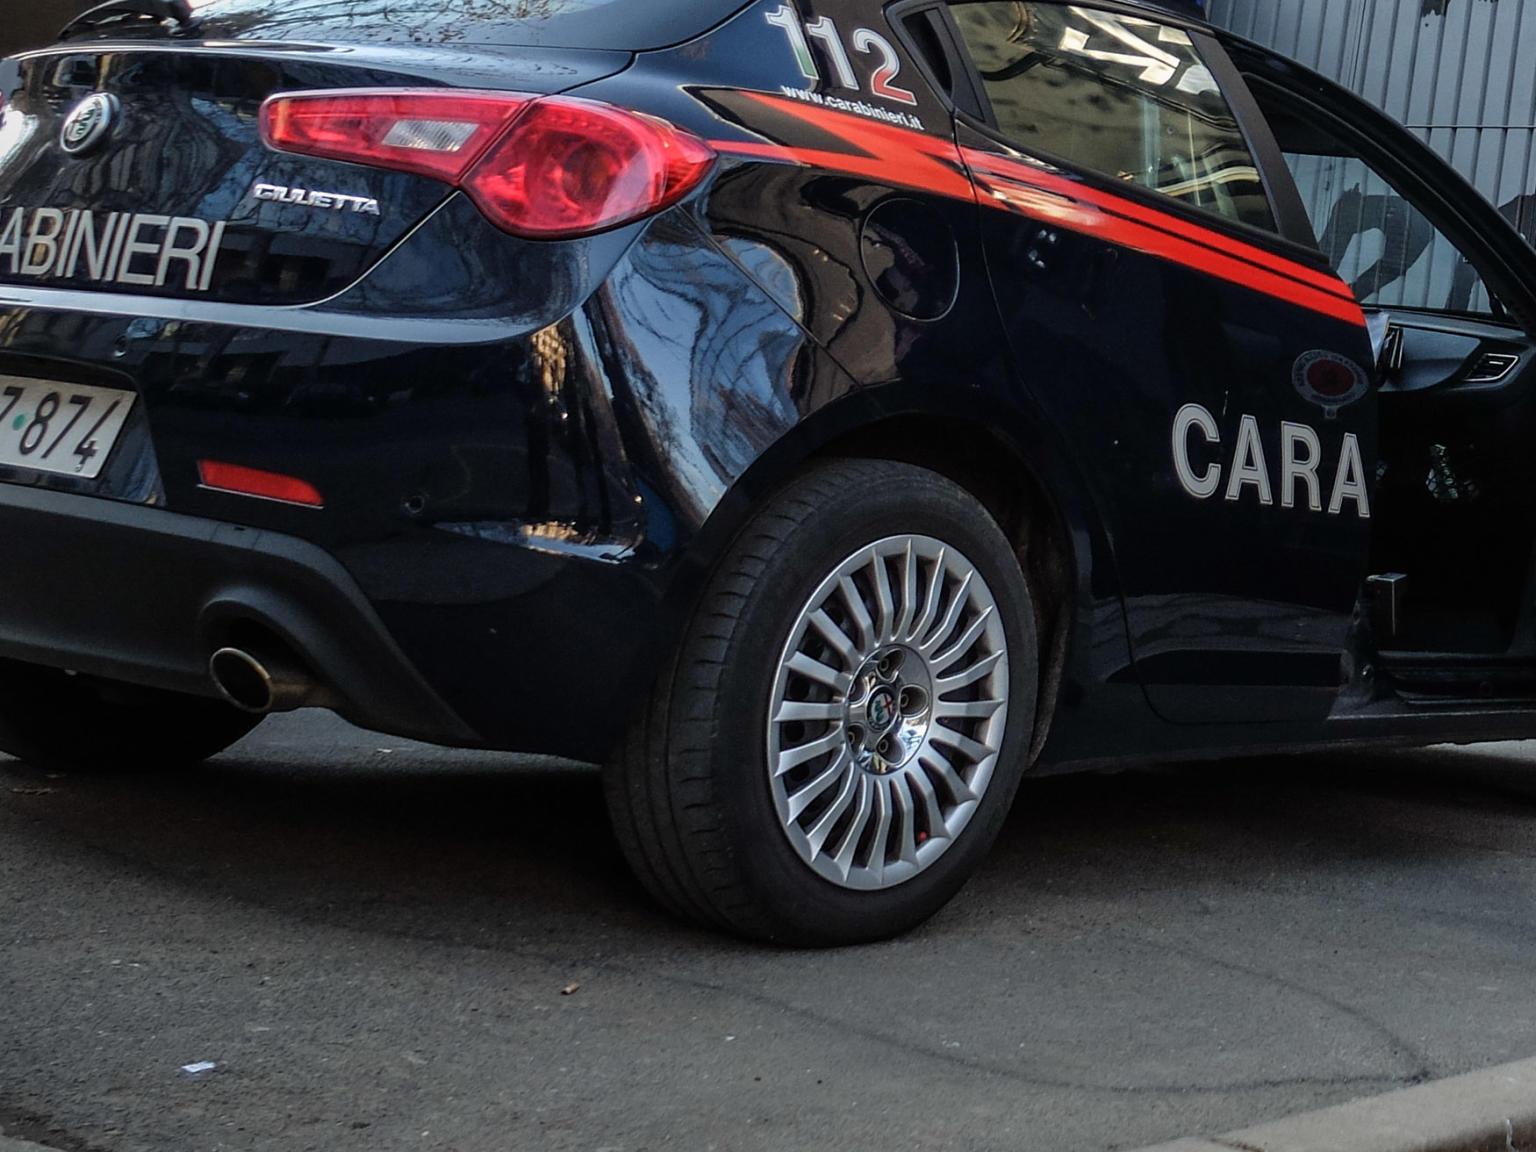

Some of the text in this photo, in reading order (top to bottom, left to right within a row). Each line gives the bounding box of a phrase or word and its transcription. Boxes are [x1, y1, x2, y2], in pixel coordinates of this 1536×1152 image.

[765, 5, 918, 106] 112
[780, 85, 925, 131] www.carabinieri.it
[253, 183, 380, 216] GIULIETTA
[1172, 403, 1371, 518] CARA
